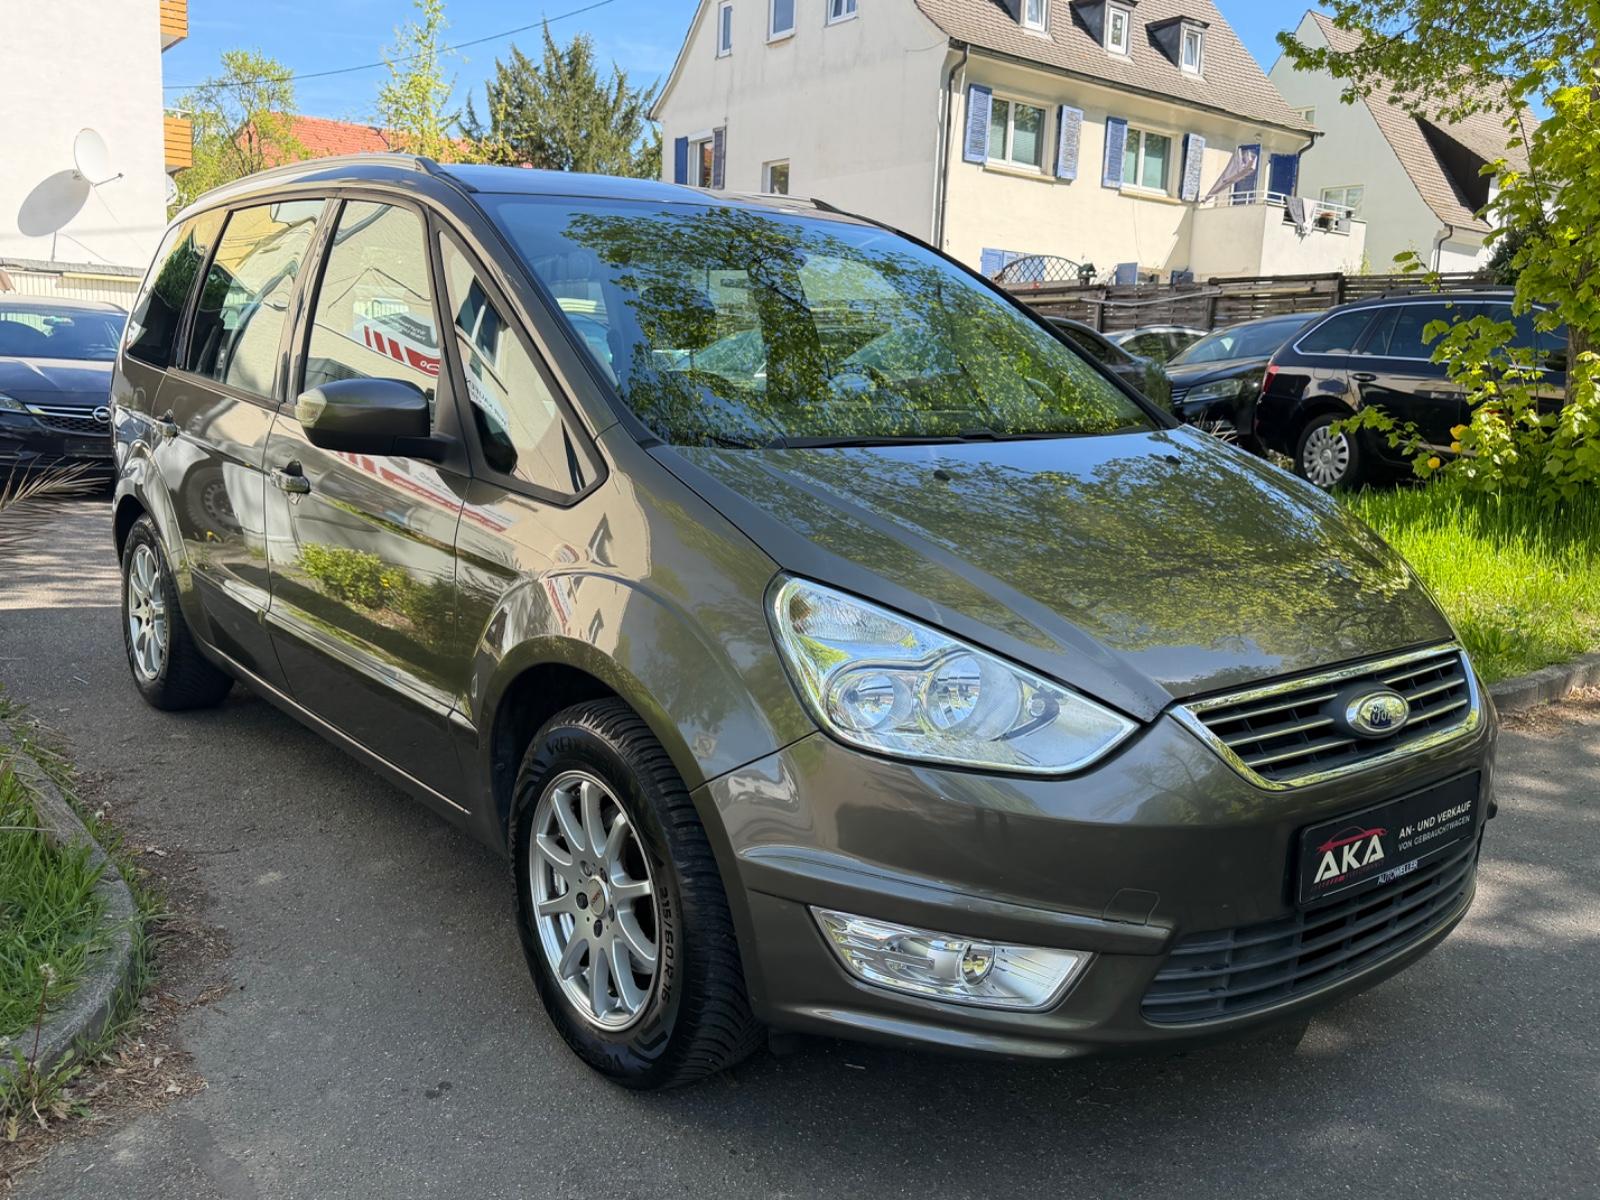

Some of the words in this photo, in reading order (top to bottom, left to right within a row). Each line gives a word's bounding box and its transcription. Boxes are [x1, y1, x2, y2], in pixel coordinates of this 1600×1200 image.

[1398, 825, 1415, 840] AN-
[1417, 816, 1436, 832] UND
[1437, 800, 1472, 823] VERKAUF
[1398, 839, 1413, 852] VON
[1413, 815, 1471, 846] GEBRAUCHTWAGEN
[1313, 834, 1386, 885] AKA
